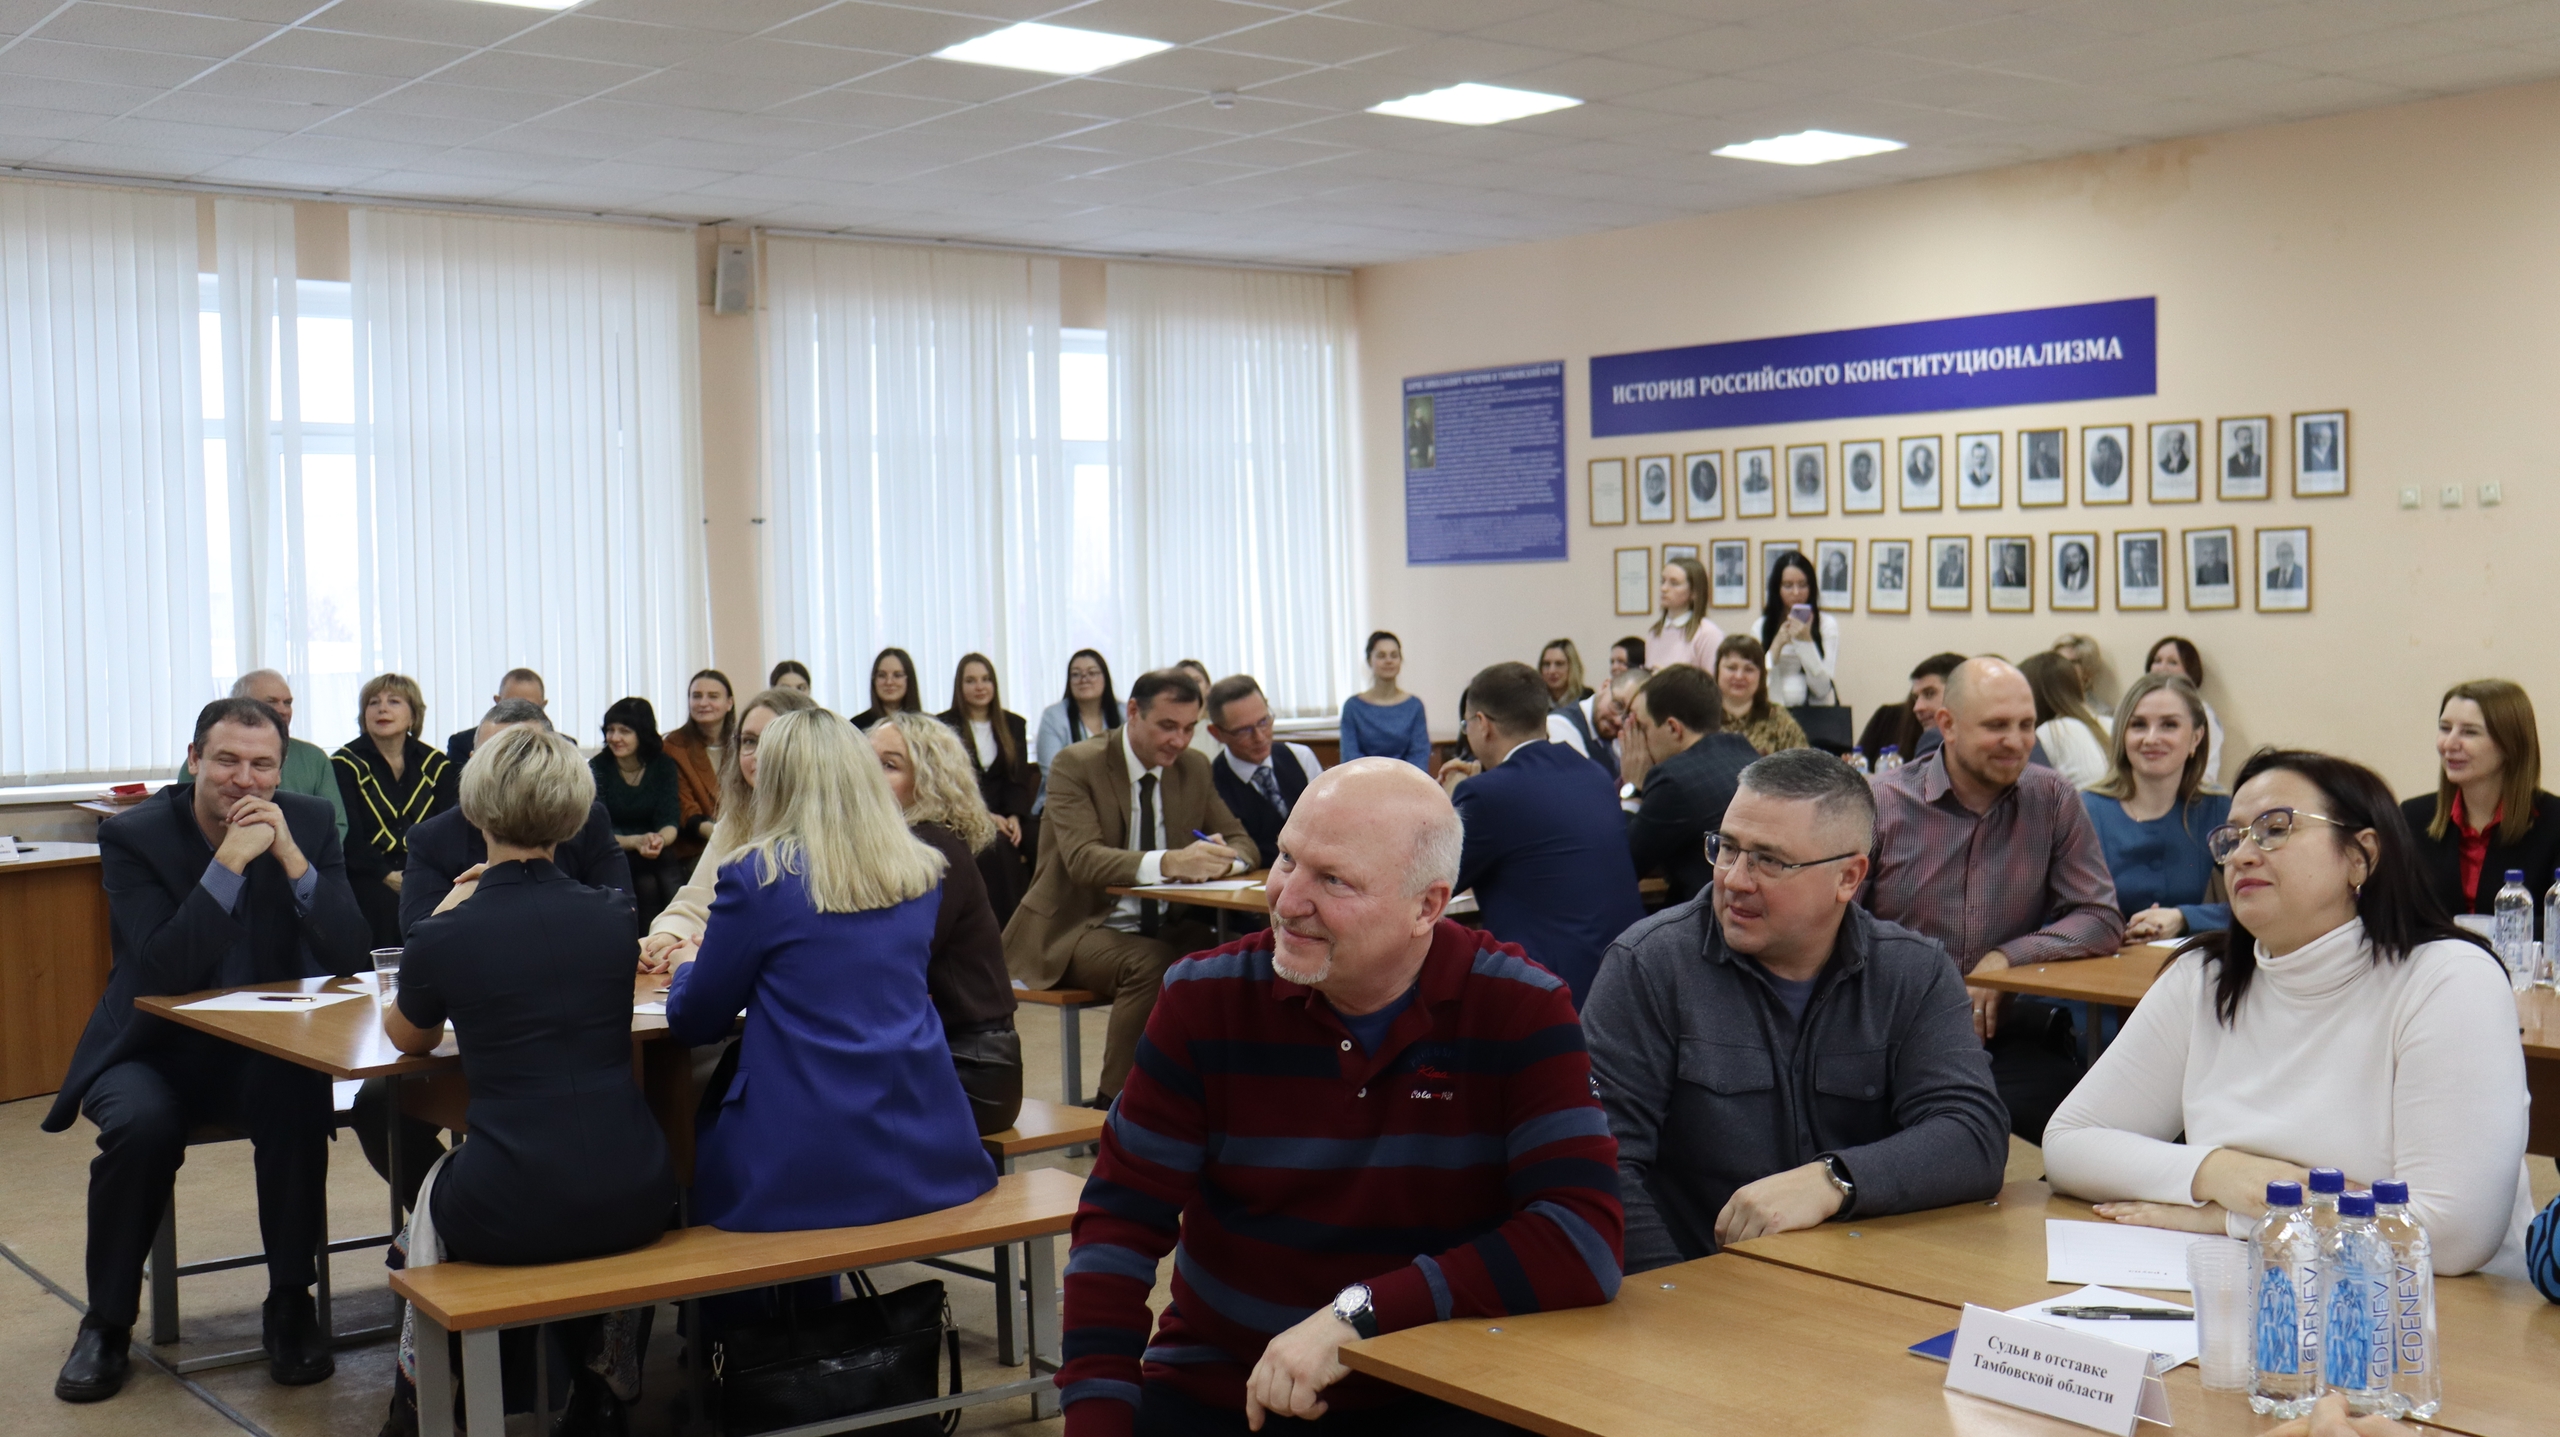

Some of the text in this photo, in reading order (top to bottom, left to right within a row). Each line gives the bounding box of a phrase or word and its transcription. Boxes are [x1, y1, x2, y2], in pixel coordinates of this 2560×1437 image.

[1612, 336, 2123, 405] ИСТОРИЯ РОССИЙСКОГО КОНСТИТУЦИОНАЛИЗМА
[2372, 1280, 2390, 1391] LEDENEV
[2397, 1265, 2426, 1375] LEDENEV
[1973, 1353, 2114, 1404] Тамбовской области
[1987, 1335, 2109, 1379] Судьи в отставке
